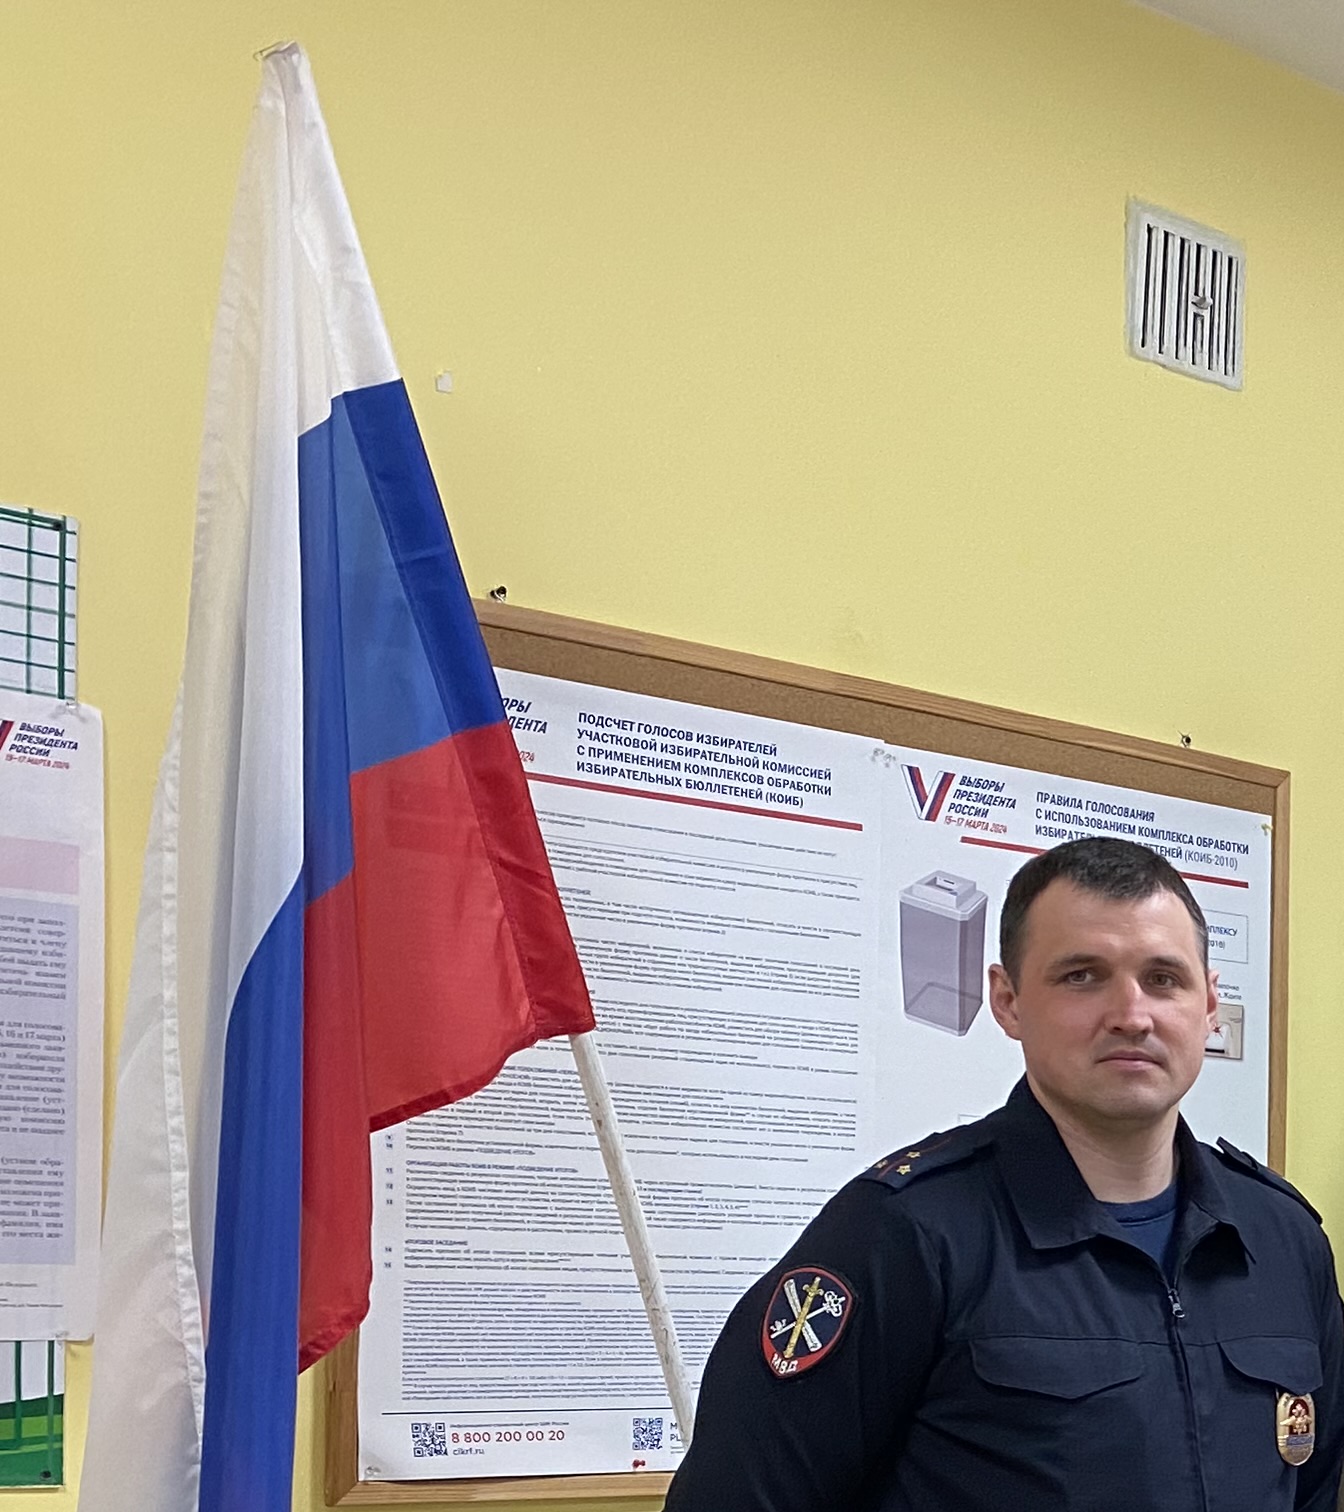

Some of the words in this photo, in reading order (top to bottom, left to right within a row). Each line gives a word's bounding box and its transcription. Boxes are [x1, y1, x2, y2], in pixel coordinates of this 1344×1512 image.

[503, 698, 532, 713] ОРЫ
[19, 722, 65, 737] ВЫБОРЫ
[509, 716, 548, 734] ДЕНТА
[14, 733, 79, 750] ПРЕЗИДЕНТА
[578, 712, 636, 732] ПОДСЧЕТ
[637, 722, 693, 742] ГОЛОСОВ
[696, 733, 778, 757] ИЗБИРАТЕЛЕЙ
[9, 744, 51, 757] РОССИИ
[520, 750, 535, 763] 024
[576, 728, 657, 752] УЧАСТКОВОЙ
[660, 744, 760, 768] ИЗБИРАТЕЛЬНОЙ
[762, 760, 832, 781] КОМИССИЕЙ
[576, 745, 585, 756] С
[588, 747, 681, 772] ПРИМЕНЕНИЕМ
[684, 763, 764, 786] КОМПЛЕКСОВ
[766, 777, 832, 796] ОБРАБОТКИ
[576, 761, 682, 788] ИЗБИРАТЕЛЬНЫХ
[685, 779, 763, 801] БЮЛЛЕТЕНЕЙ
[765, 792, 804, 808] (КОИБ)
[959, 775, 1006, 793] ВЫБОРЫ
[952, 788, 1017, 810] ПРЕЗИДЕНТА
[1036, 791, 1083, 810] ПРАВИЛА
[1085, 800, 1155, 822] ГОЛОСОВАНИЯ
[947, 802, 989, 819] РОССИИ
[964, 819, 989, 832] МАРТА
[989, 823, 1008, 834] 2024
[1035, 808, 1043, 819] С
[1044, 810, 1136, 836] ИСПОЛЬЗОВАНИЕМ
[1138, 826, 1194, 846] КОМПЛЕКСА
[1196, 837, 1249, 855] ОБРАБОТКИ
[1035, 824, 1096, 840] ИЗБИРАТЕЛ
[1184, 849, 1238, 871] (КОИБ-2010)
[451, 1432, 460, 1443] 8
[463, 1431, 491, 1443] 800
[495, 1430, 522, 1442] 200
[526, 1430, 544, 1441] 00
[548, 1430, 565, 1441] 20
